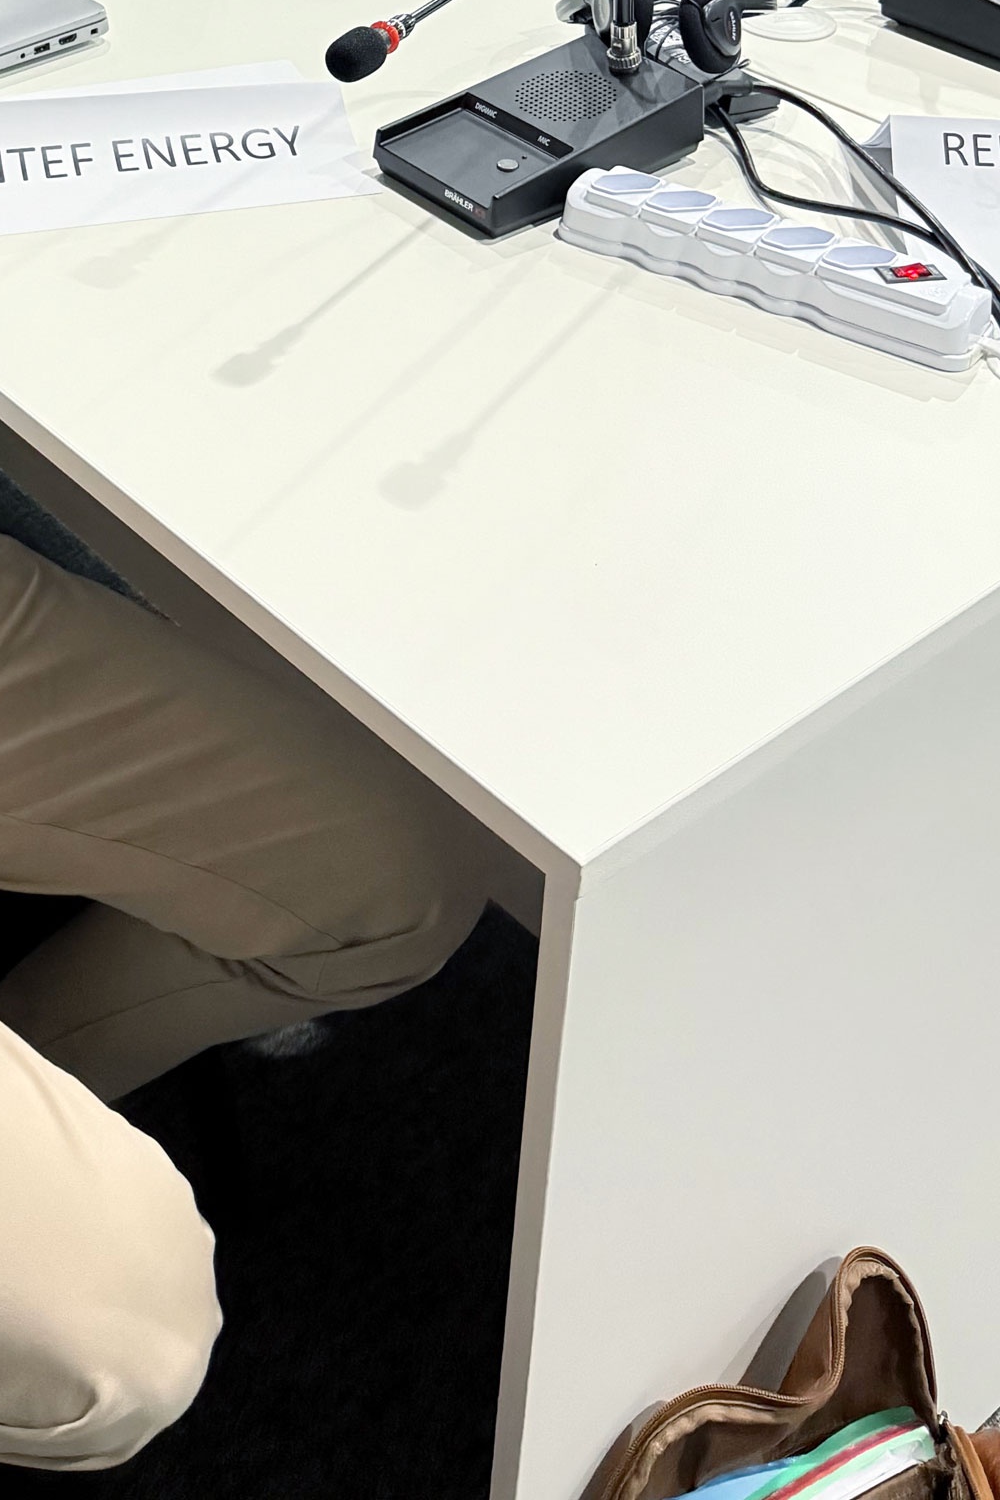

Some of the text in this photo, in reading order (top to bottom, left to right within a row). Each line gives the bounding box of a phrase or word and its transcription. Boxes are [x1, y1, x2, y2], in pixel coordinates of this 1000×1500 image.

[111, 125, 300, 173] ENERGY
[537, 135, 551, 147] MIC
[943, 132, 1000, 167] RE
[444, 188, 474, 212] BRÄHLER
